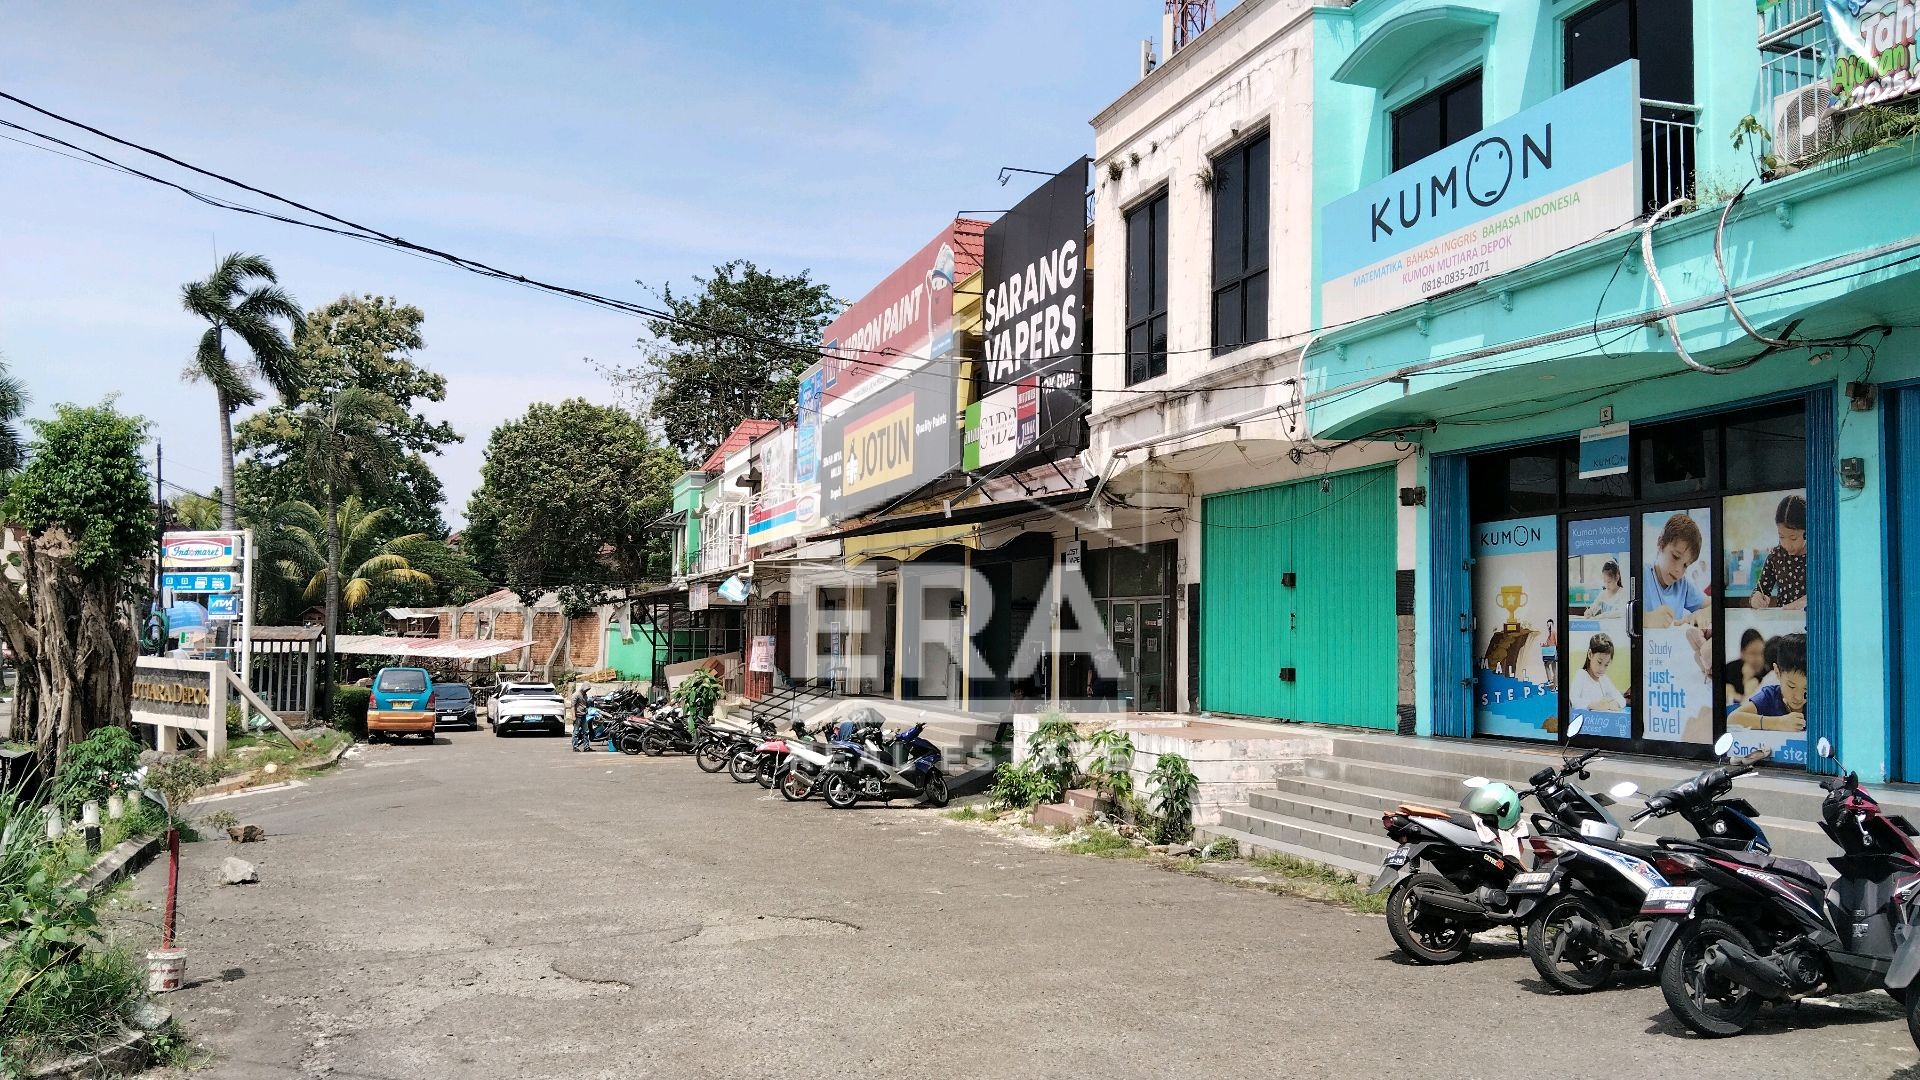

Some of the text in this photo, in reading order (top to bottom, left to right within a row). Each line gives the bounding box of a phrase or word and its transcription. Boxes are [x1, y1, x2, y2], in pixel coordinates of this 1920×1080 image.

[1371, 122, 1552, 242] KUMON
[1353, 191, 1580, 287] MATEMATIKA BAHASA INGGRIS BAHASA INDONESIA
[1402, 234, 1512, 285] KUMON MUTIARA DEPOK
[985, 239, 1078, 333] SARANG
[1421, 261, 1490, 294] 0818-0835-2071
[839, 283, 923, 373] NIPPON PAINT
[984, 294, 1076, 383] VAPERS
[916, 412, 947, 436] Quality Paints
[859, 416, 910, 481] JOTUN
[1593, 454, 1626, 468] KUMON
[1480, 525, 1541, 546] KUMON
[1575, 535, 1625, 549] gives value to
[1599, 525, 1629, 535] Method
[172, 546, 220, 557] Indomaret
[211, 600, 233, 608] ATM
[1649, 640, 1672, 658] Study
[1648, 667, 1675, 688] just-
[131, 682, 175, 702] UTIARA
[1481, 683, 1545, 705] STEPS
[1648, 684, 1686, 713] right
[1649, 709, 1681, 735] level
